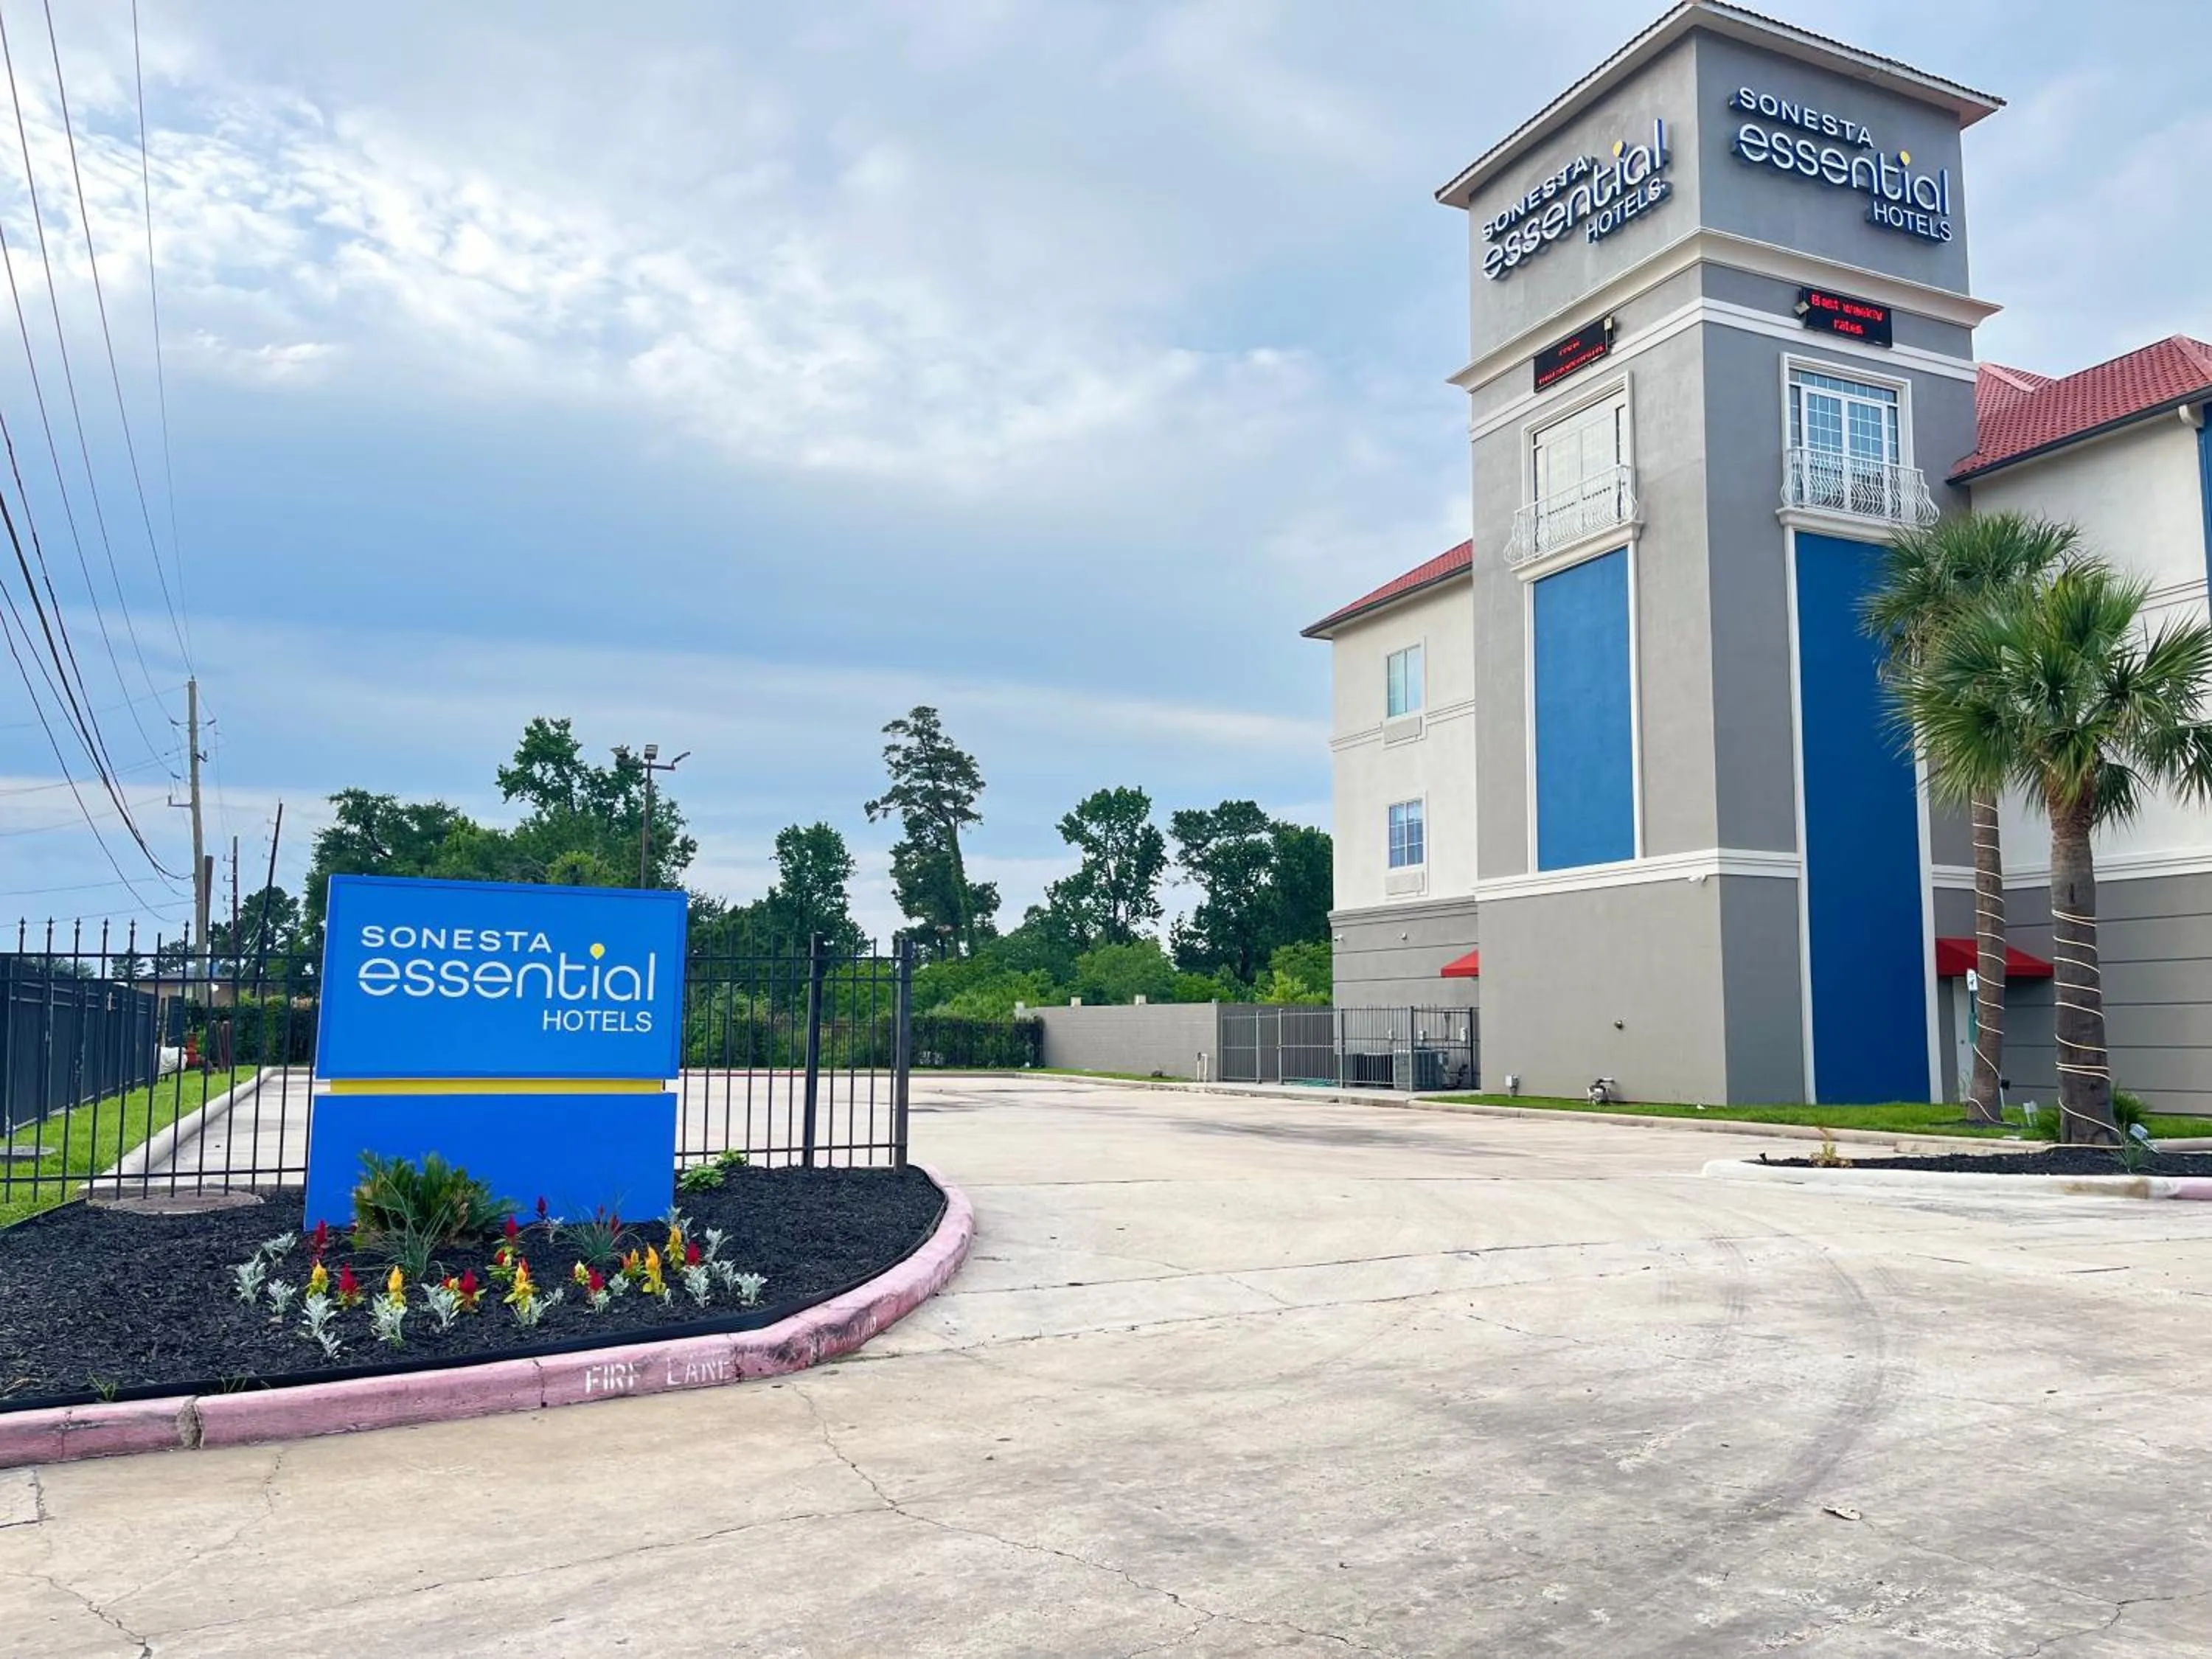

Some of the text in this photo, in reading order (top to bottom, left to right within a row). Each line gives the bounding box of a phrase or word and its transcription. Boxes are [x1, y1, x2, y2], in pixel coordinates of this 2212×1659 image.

[1739, 87, 1875, 148] SONESTA
[1481, 155, 1590, 242] SONESTA
[1483, 118, 1665, 280] essential
[1739, 123, 1950, 216] essential
[1586, 178, 1666, 243] HOTELS
[1874, 200, 1953, 242] HOTELS
[361, 925, 552, 953] SONESTA
[358, 942, 656, 1002] essential
[542, 1009, 653, 1033] HOTELS
